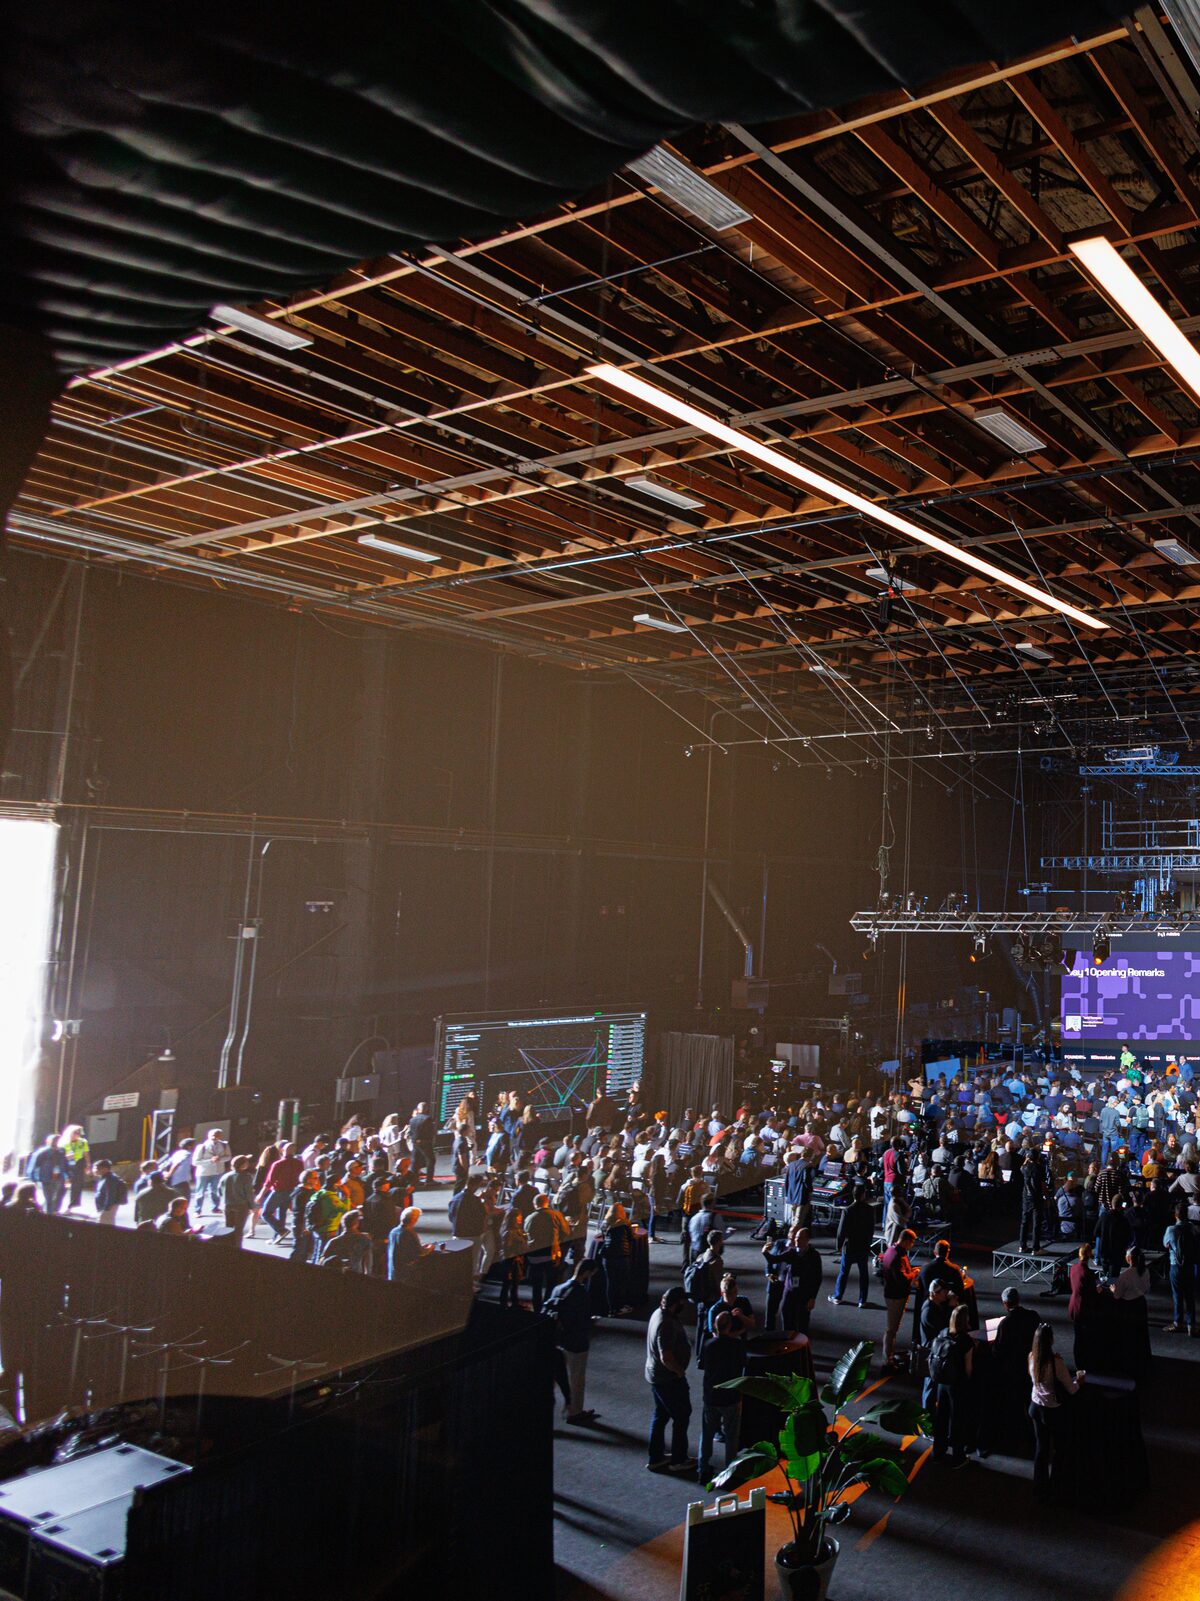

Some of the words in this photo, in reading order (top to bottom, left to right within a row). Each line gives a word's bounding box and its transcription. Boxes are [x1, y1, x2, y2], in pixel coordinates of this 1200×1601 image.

[1070, 968, 1084, 979] ay
[1084, 967, 1090, 976] 1
[1090, 967, 1128, 979] Opening
[1128, 967, 1165, 977] Remarks
